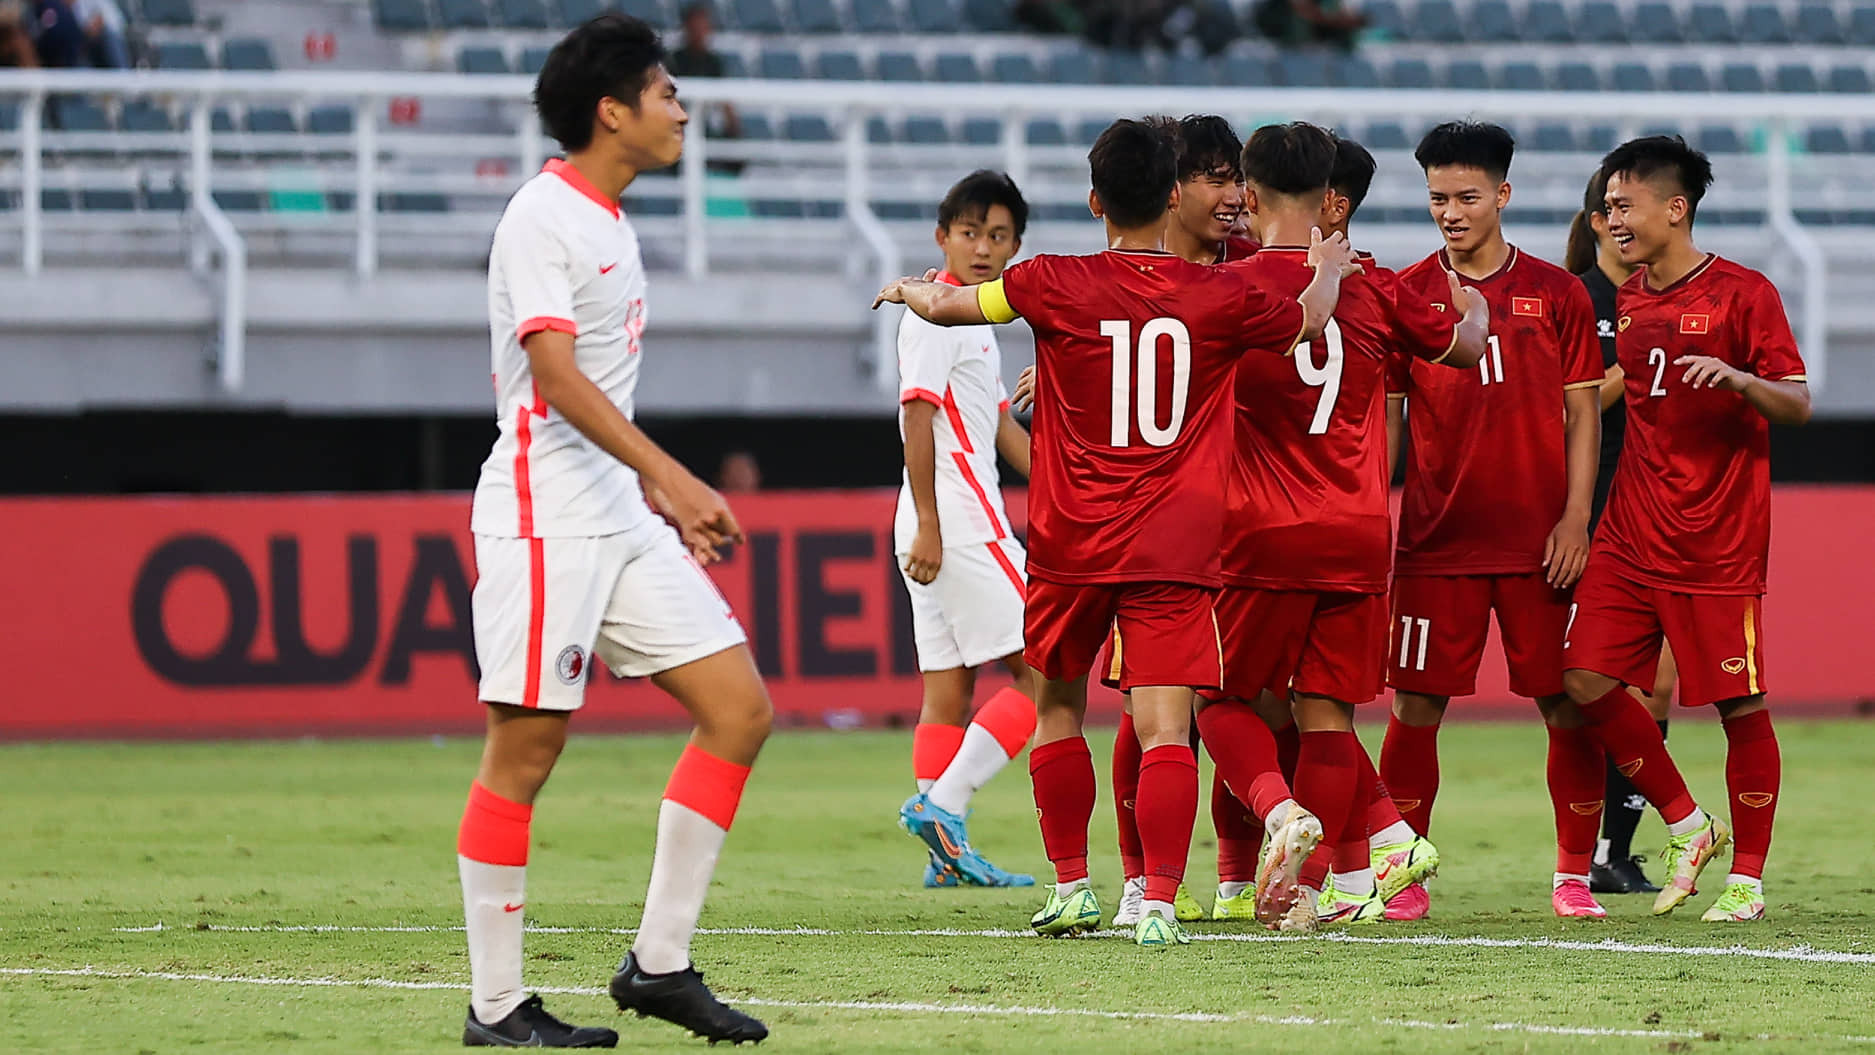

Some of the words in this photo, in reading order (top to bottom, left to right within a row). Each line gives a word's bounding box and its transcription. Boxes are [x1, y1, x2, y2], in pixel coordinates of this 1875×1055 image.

[1100, 316, 1191, 448] 10
[1294, 315, 1344, 435] 9
[1479, 335, 1504, 386] 11
[1648, 347, 1667, 396] 2
[1399, 615, 1430, 670] 11
